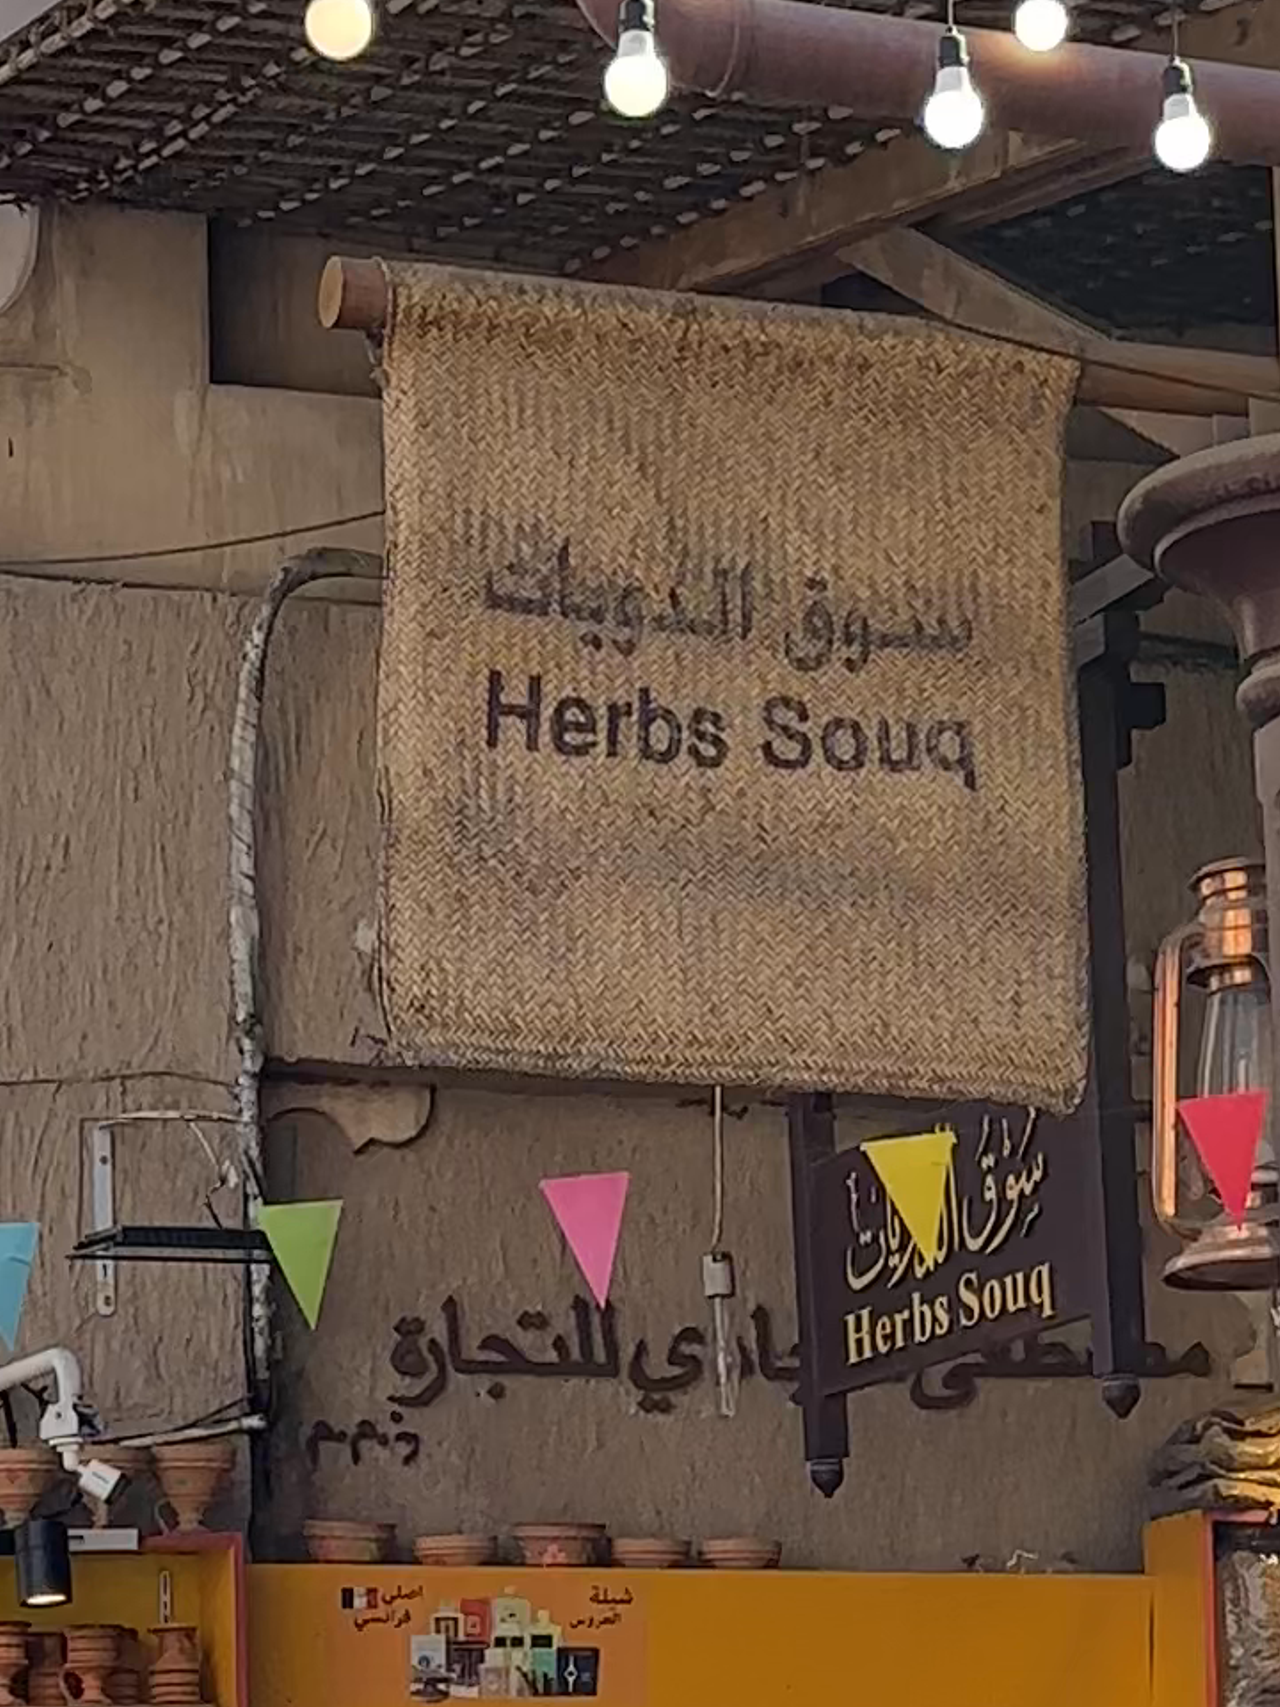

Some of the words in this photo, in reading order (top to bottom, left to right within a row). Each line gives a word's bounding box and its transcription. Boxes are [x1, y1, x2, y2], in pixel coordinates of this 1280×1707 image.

[783, 576, 973, 673] سوق
[487, 670, 728, 769] Herbs
[761, 695, 976, 792] Souq
[388, 1294, 619, 1408] للتجارة
[845, 1292, 949, 1365] Herbs
[958, 1261, 1055, 1330] Souq
